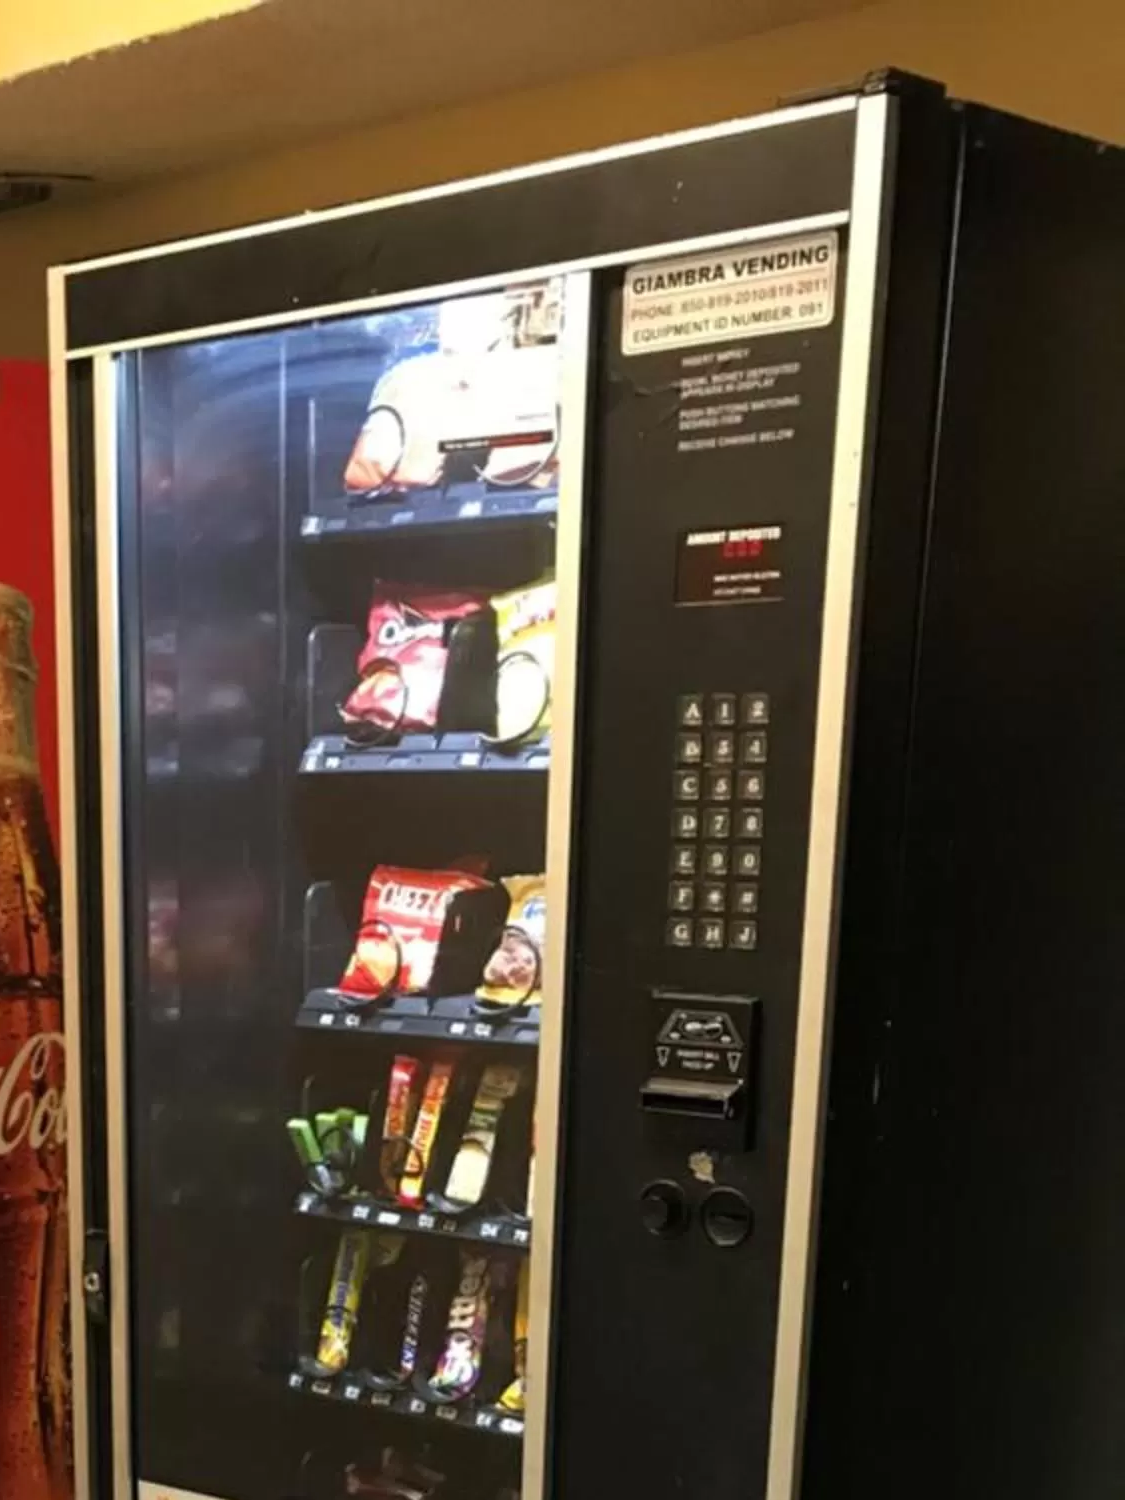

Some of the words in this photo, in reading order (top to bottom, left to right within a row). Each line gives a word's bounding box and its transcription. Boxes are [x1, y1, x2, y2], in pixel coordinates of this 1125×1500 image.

[632, 264, 725, 294] GIAMBRA
[732, 245, 829, 277] VENDING
[633, 319, 710, 343] EQUIPMENT
